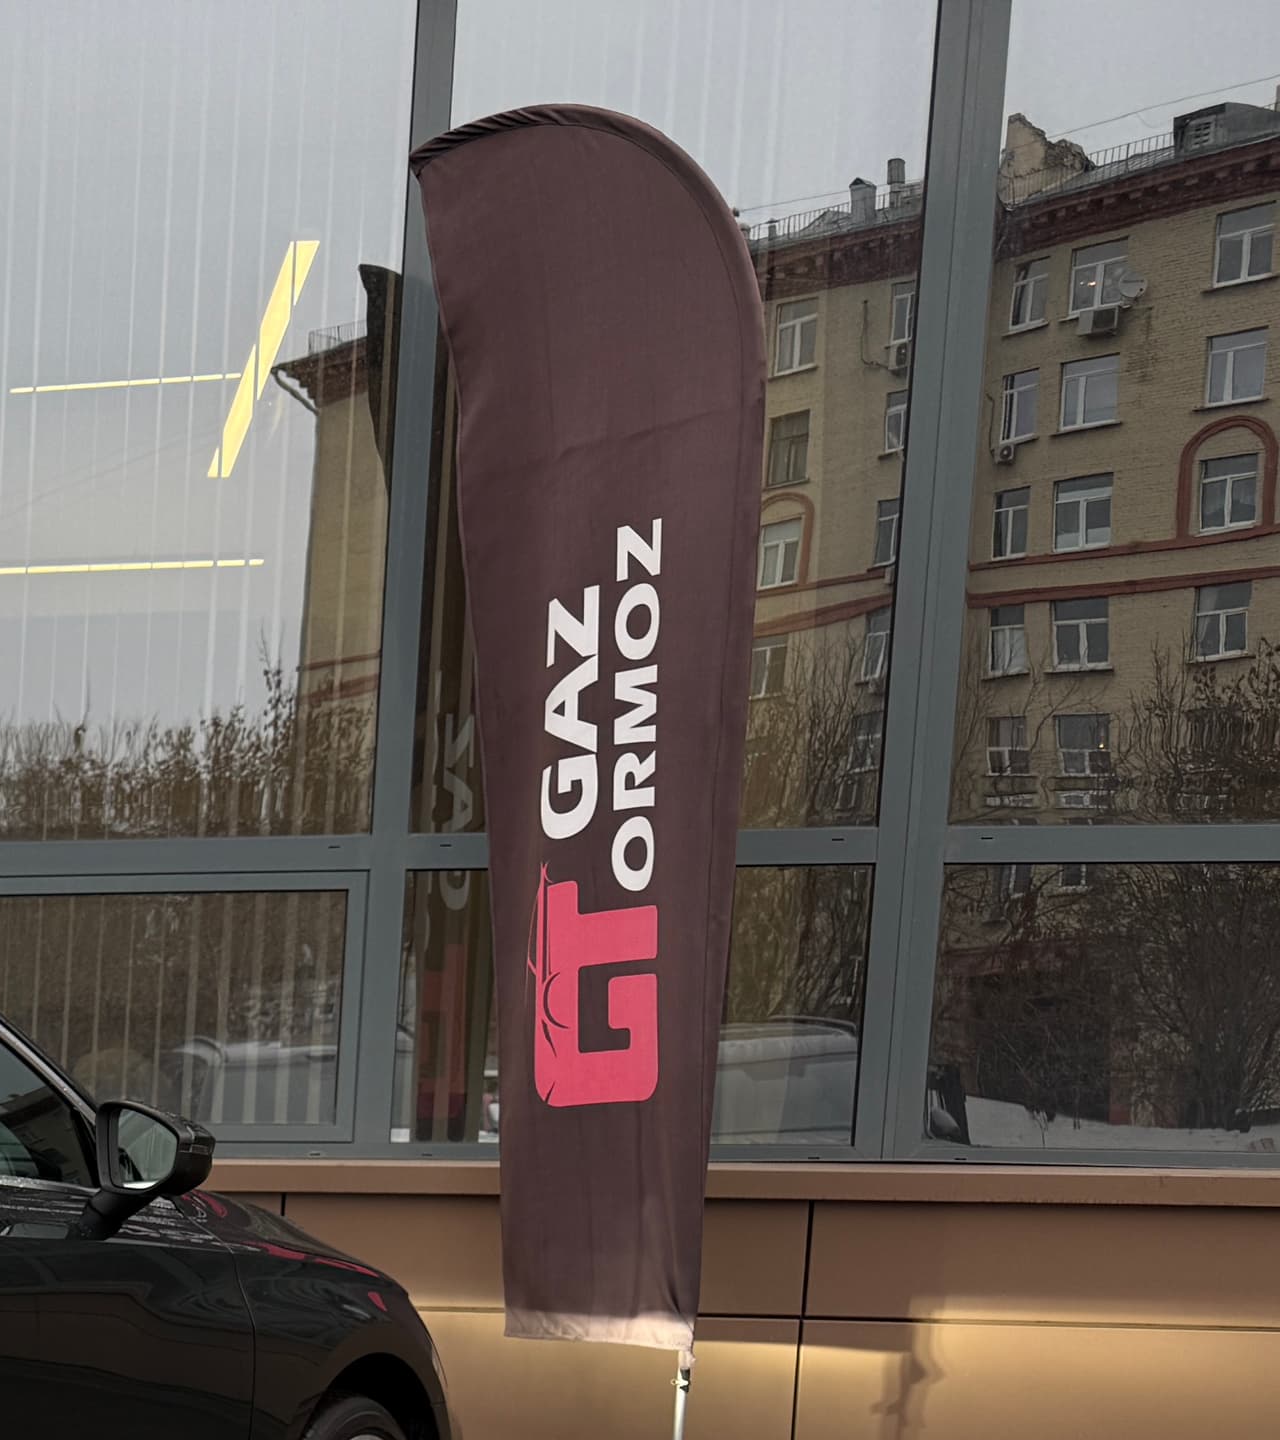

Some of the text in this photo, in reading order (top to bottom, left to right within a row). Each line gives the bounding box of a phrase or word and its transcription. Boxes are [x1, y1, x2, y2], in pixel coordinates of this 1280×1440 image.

[541, 584, 600, 840] GAZ
[611, 517, 662, 892] ORMOZ
[535, 878, 658, 1107] GT
